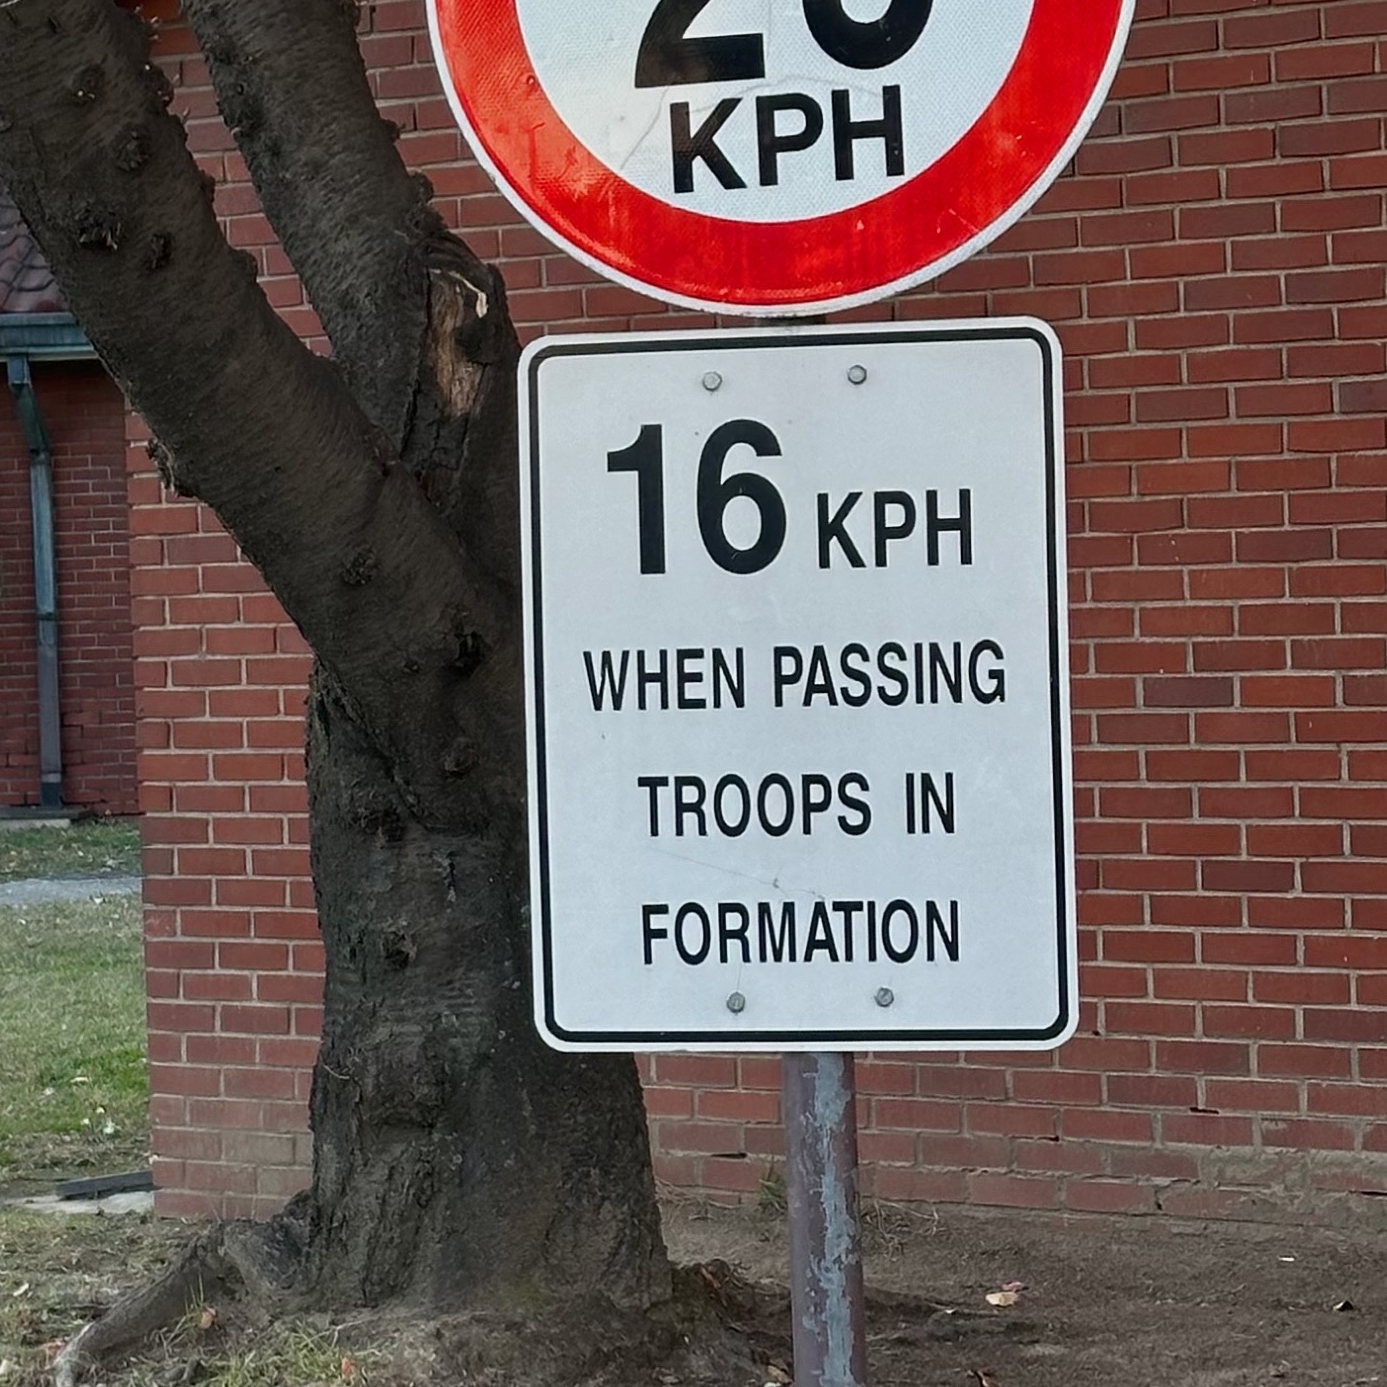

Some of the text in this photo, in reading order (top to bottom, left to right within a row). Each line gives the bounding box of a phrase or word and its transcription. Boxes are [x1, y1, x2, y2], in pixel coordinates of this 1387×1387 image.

[669, 84, 905, 194] KPH
[606, 419, 973, 575] 16 KPH
[582, 639, 1006, 712] WHEN PASSING
[637, 771, 955, 838] TROOPS IN
[641, 898, 960, 966] FORMATION
